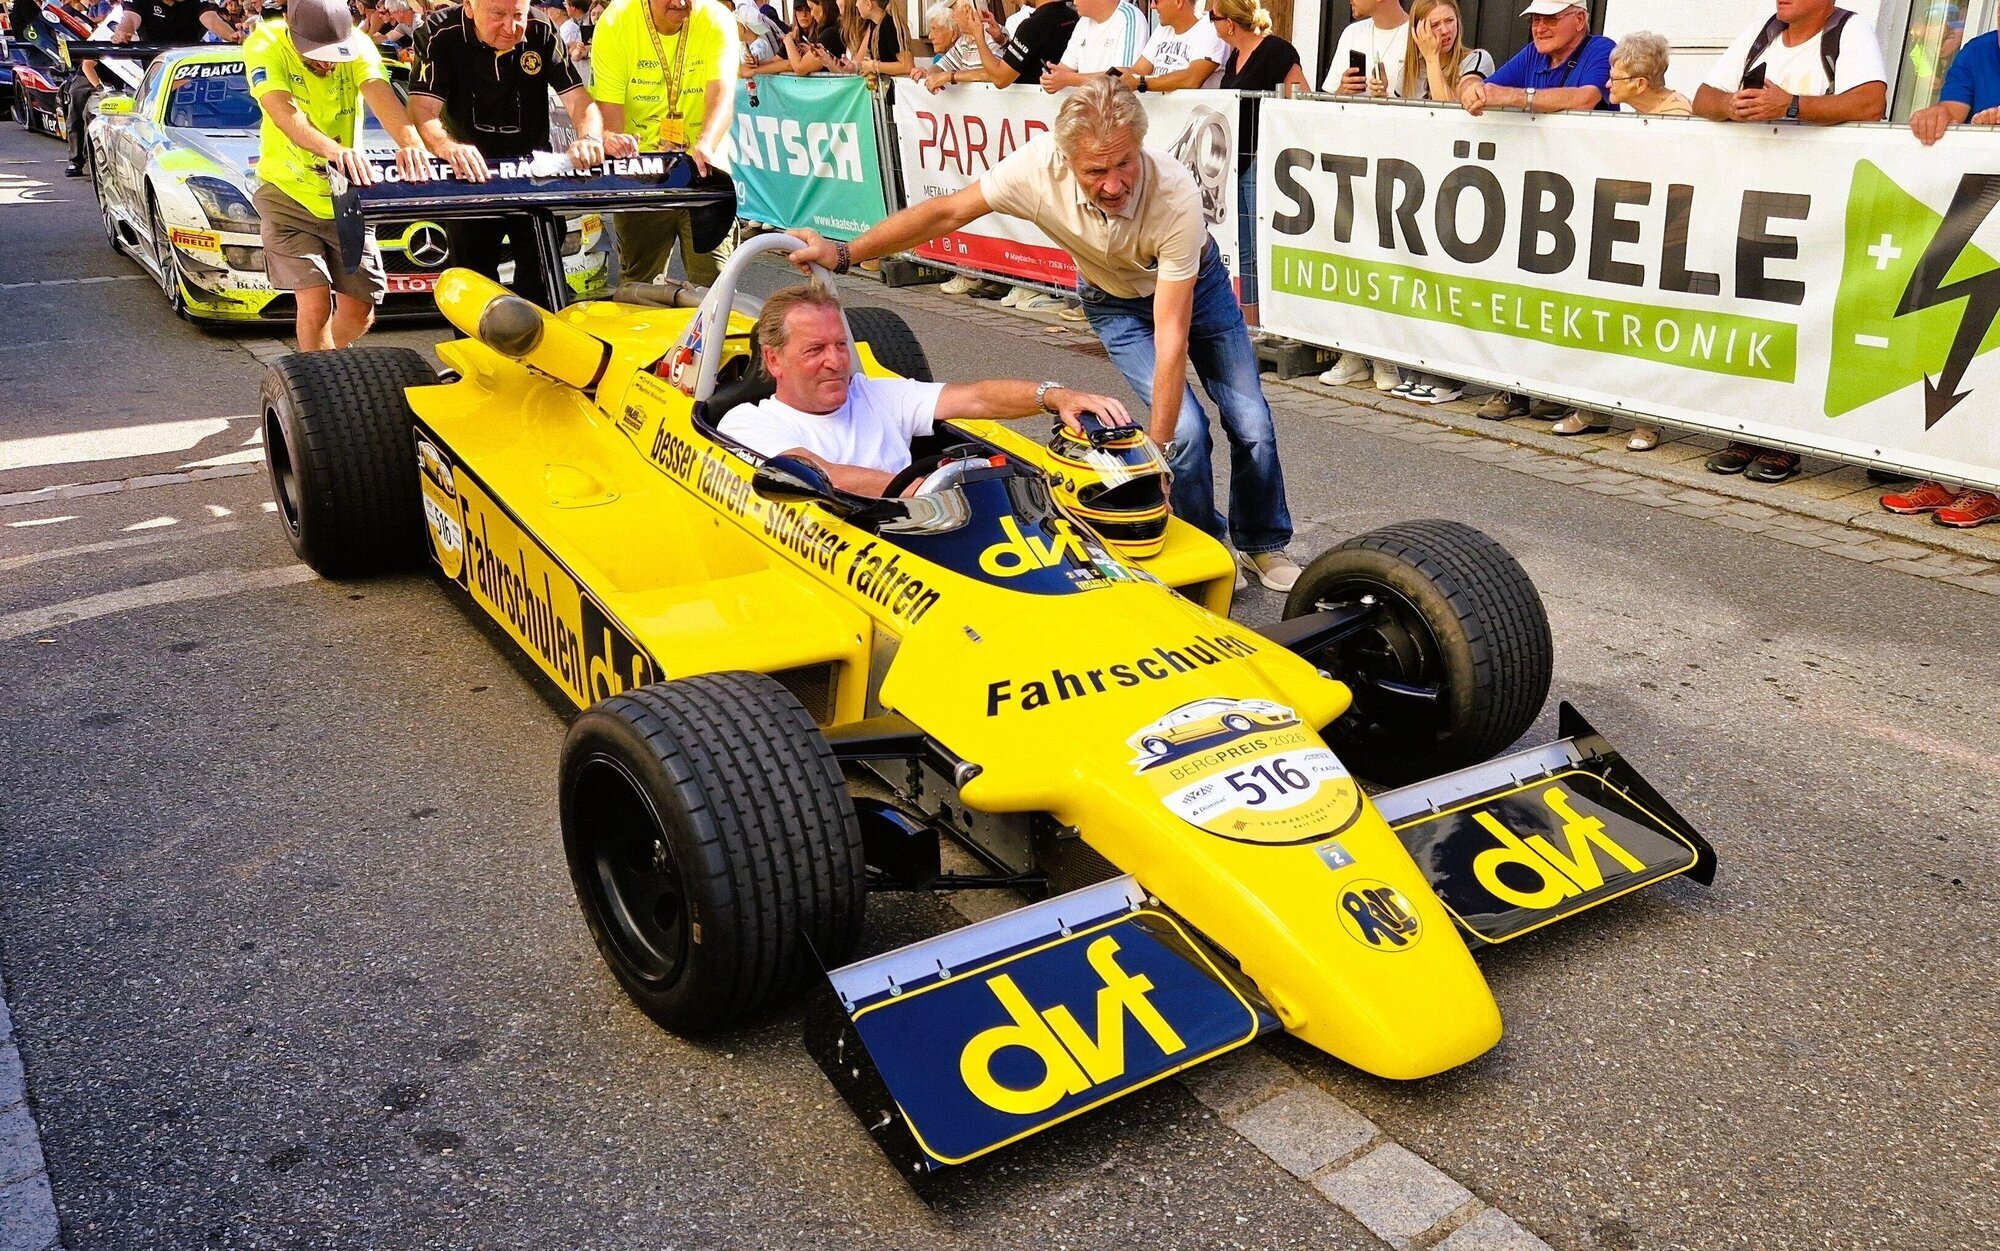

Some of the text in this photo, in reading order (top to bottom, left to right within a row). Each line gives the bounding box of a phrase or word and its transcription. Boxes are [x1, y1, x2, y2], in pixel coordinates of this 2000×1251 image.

[174, 63, 244, 80] 84 BAKU
[173, 231, 215, 248] PIRELLI
[1272, 140, 1812, 306] STRÖBELE
[1283, 256, 1772, 369] INDUSTRIE-ELEKTRONIK
[435, 506, 452, 546] 516
[651, 417, 699, 483] besser
[697, 446, 752, 518] fahren
[764, 500, 851, 576] sicherer
[846, 541, 941, 625] fahren
[978, 515, 1091, 578] dvf
[460, 493, 585, 699] Fahrschulen
[986, 634, 1259, 717] Fahrschulen
[1170, 732, 1308, 780] BERGPREIS 2026
[1224, 758, 1310, 805] 516
[1472, 786, 1647, 910] dvf
[959, 934, 1187, 1115] dvf
